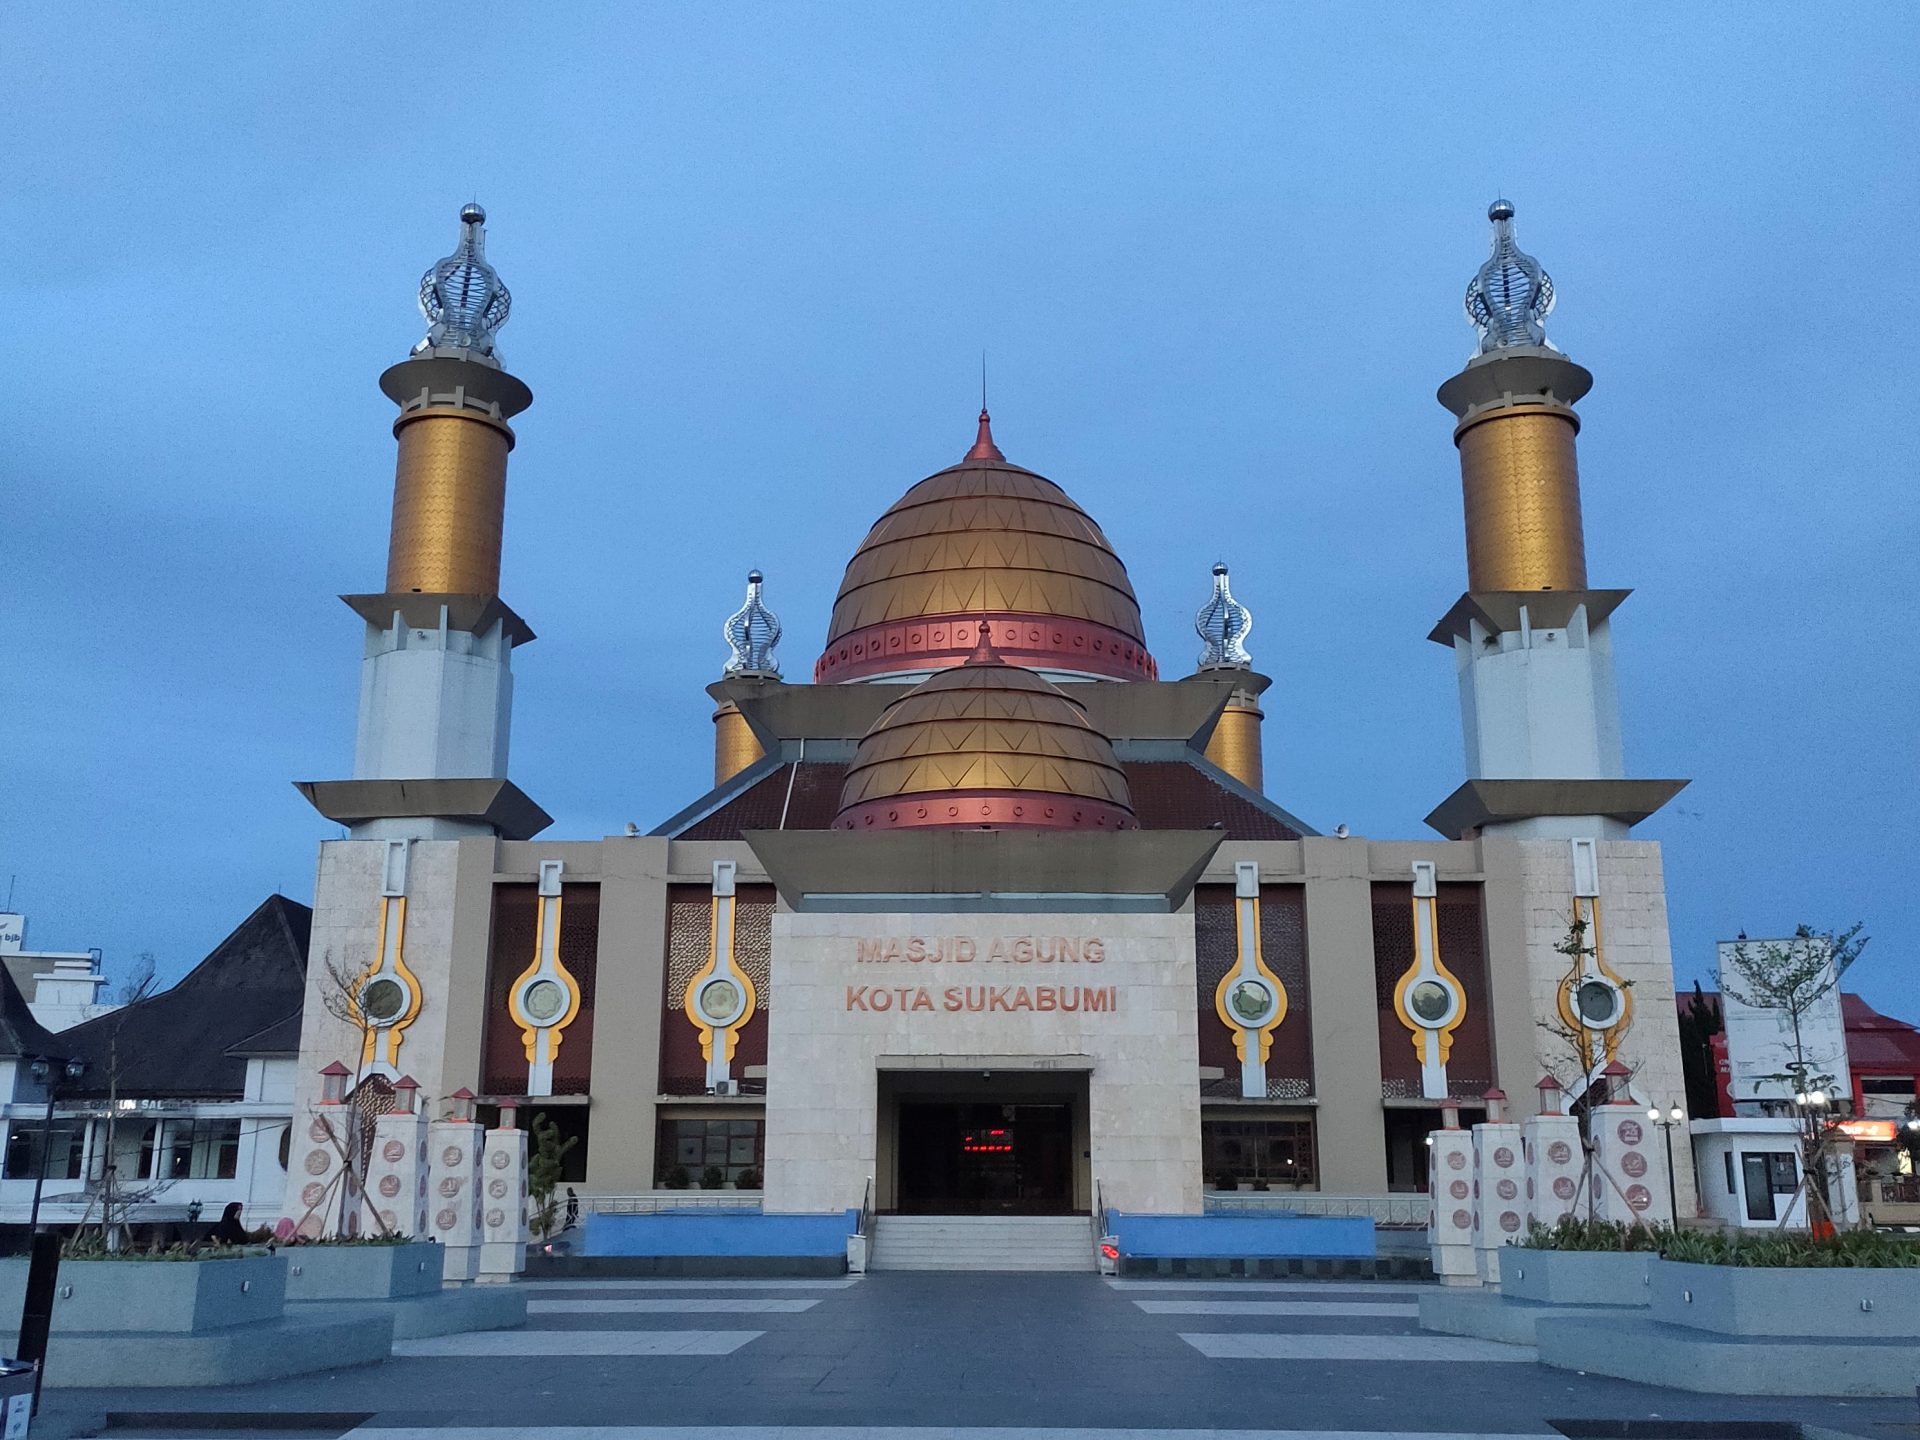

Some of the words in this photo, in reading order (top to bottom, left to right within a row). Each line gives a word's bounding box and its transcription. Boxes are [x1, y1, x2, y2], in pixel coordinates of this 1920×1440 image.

[857, 936, 976, 962] MASJID
[987, 936, 1106, 963] AGUNG
[846, 986, 935, 1012] KOTA
[943, 986, 1117, 1012] SUKABUMI
